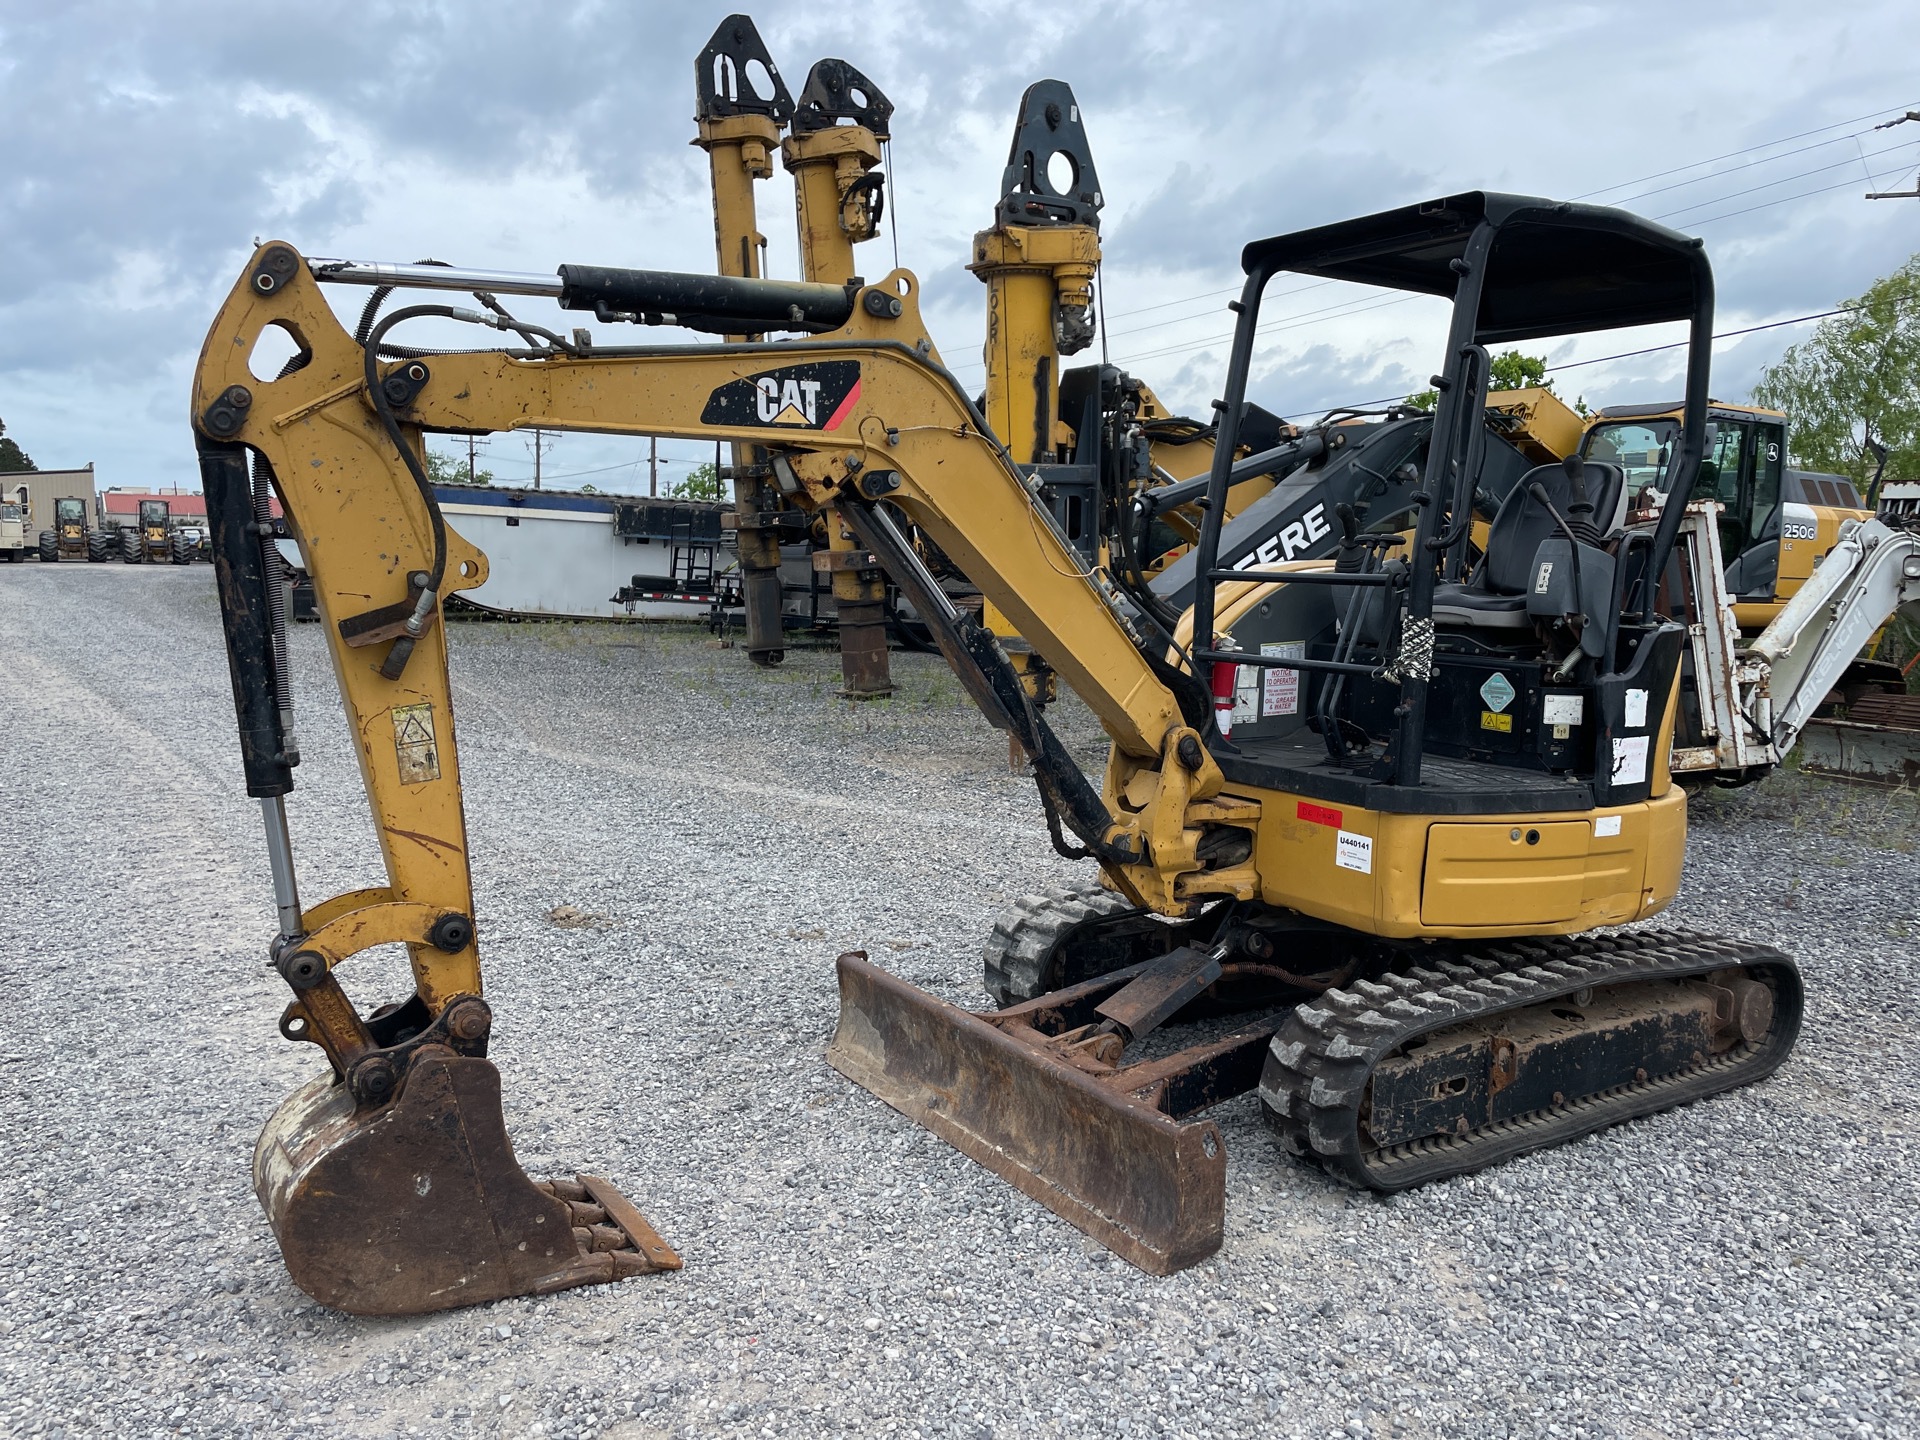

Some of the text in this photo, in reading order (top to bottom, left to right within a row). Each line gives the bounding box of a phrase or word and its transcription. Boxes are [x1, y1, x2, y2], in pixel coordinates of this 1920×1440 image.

[989, 276, 999, 378] LODRIL
[757, 377, 820, 424] CAT
[1784, 524, 1815, 540] 250G
[1340, 837, 1370, 850] U440141
